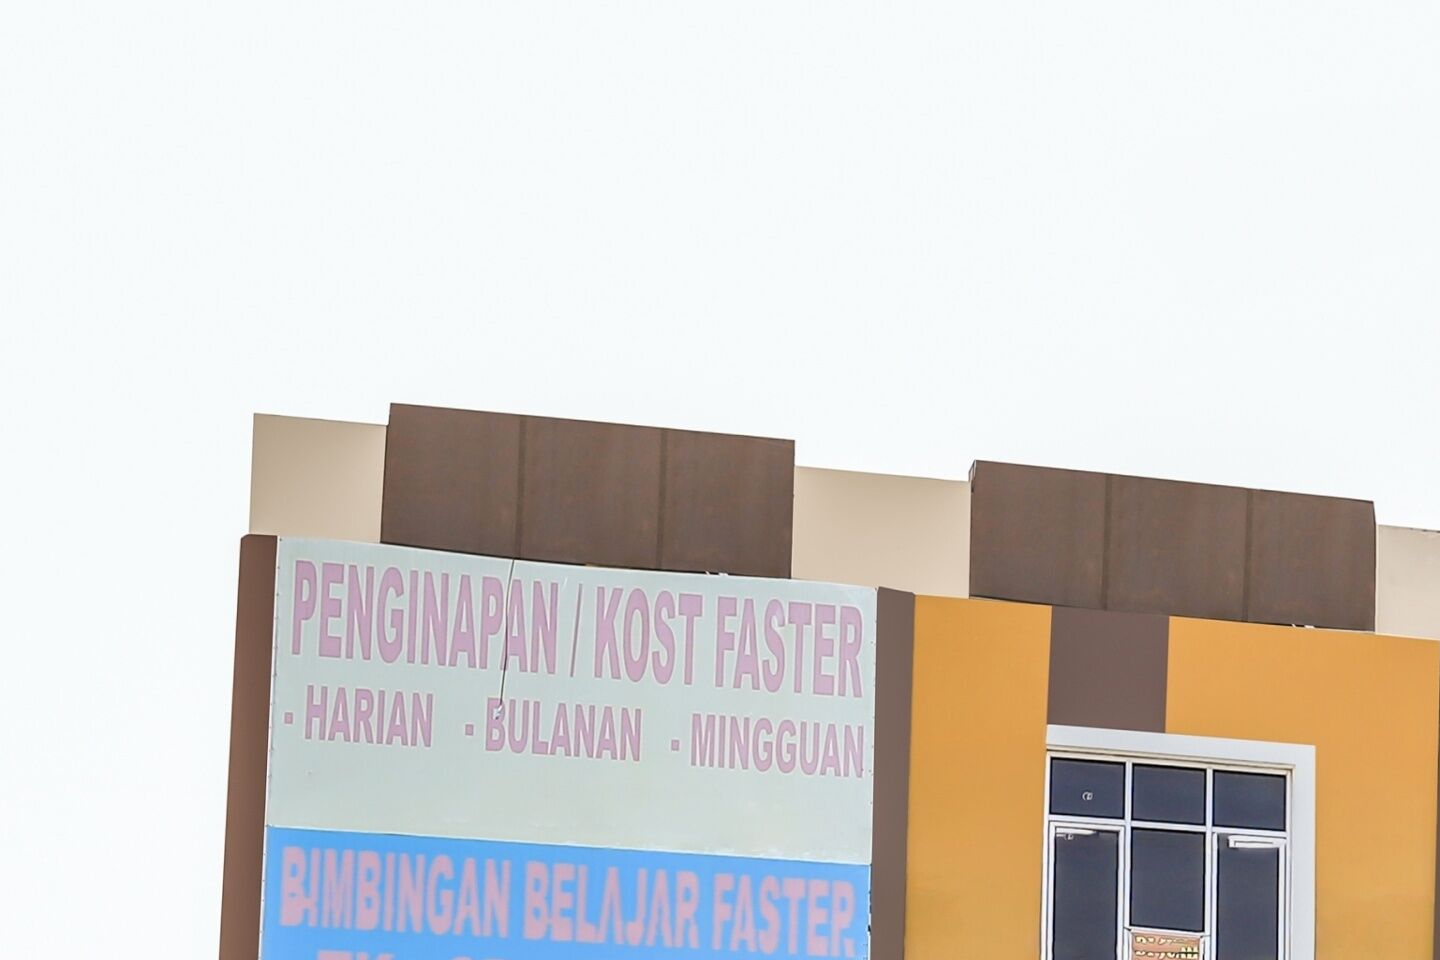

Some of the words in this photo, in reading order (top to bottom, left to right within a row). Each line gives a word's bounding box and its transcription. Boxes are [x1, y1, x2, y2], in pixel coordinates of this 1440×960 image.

[292, 560, 558, 675] PENGINAPAN
[595, 586, 702, 685] KOST
[715, 596, 863, 697] FASTER
[305, 685, 434, 747] HARIAN
[485, 697, 642, 762] BULANAN
[691, 713, 865, 778] MINGGUAN
[523, 860, 699, 949] BELAJAR
